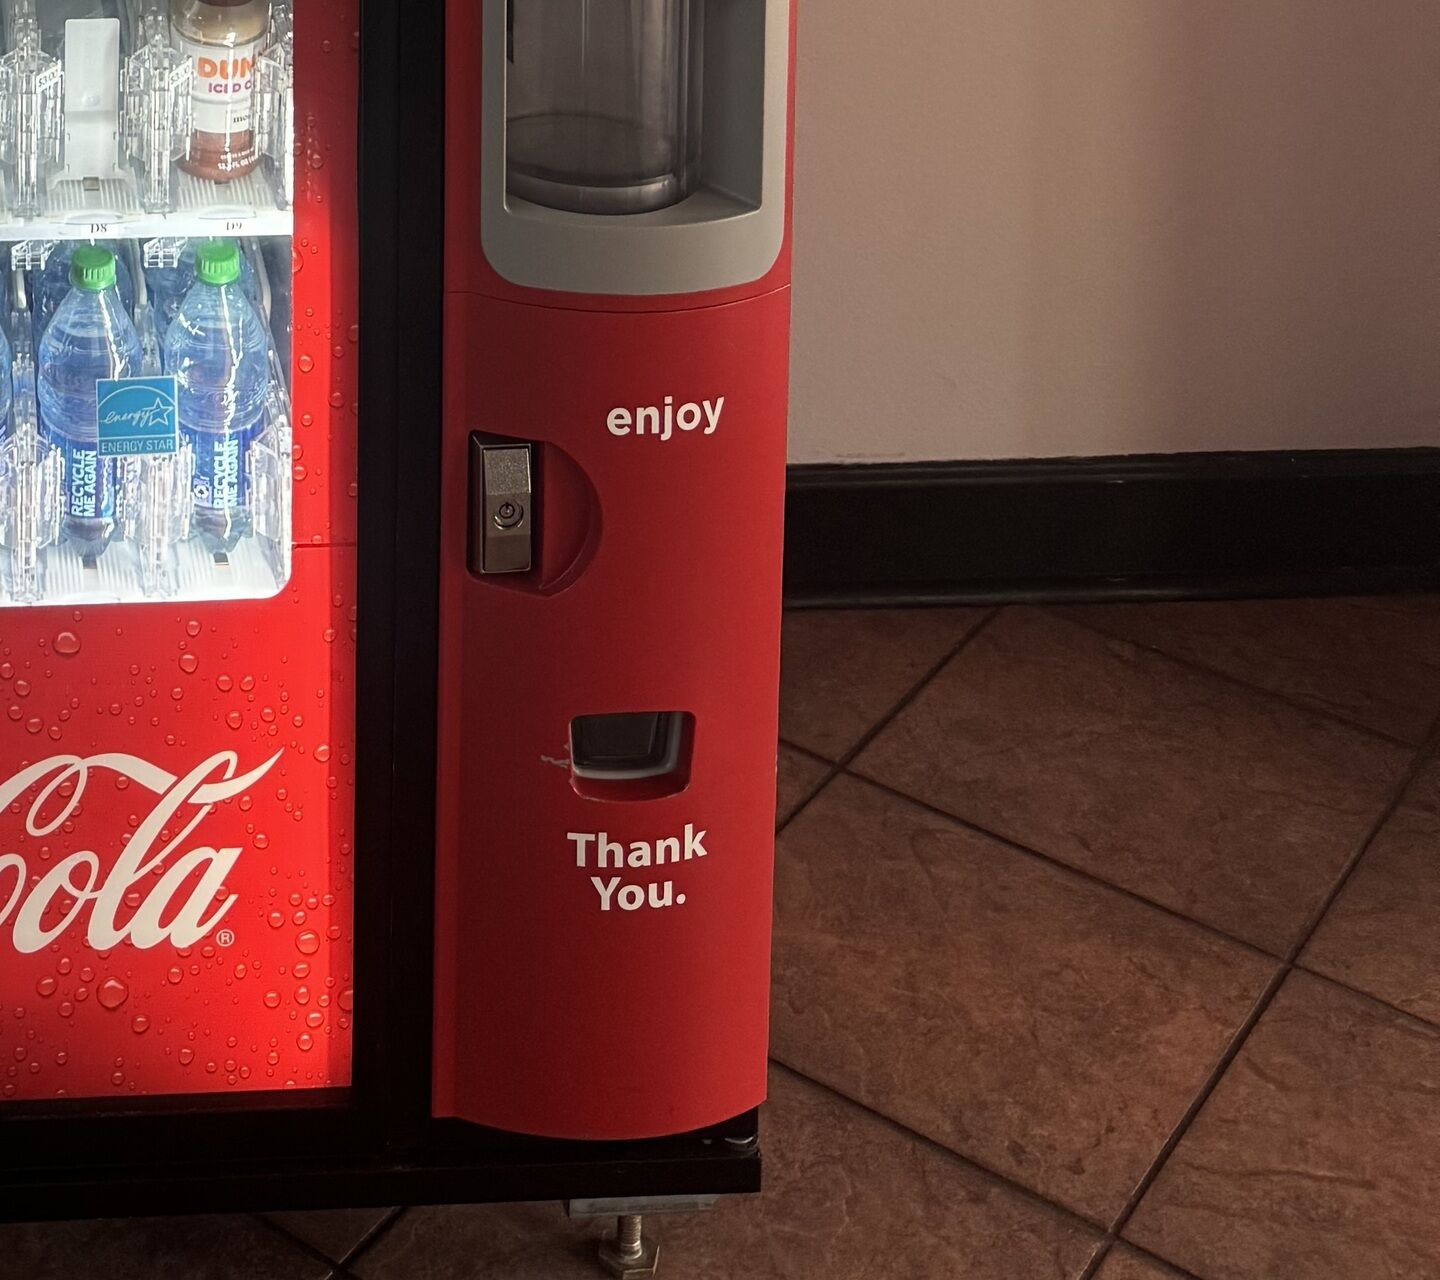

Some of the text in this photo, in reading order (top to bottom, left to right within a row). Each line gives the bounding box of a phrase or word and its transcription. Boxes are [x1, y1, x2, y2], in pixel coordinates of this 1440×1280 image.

[38, 69, 60, 88] $3.00
[197, 57, 255, 80] DUN
[90, 222, 107, 233] D8
[225, 221, 242, 231] D9
[105, 405, 151, 426] energy
[605, 395, 725, 440] enjoy
[101, 439, 173, 453] ENERGY STAR
[71, 448, 86, 517] RECYCLE
[84, 450, 97, 517] ME AGAIN
[213, 441, 227, 509] RECYCLE
[567, 823, 708, 869] Thank
[590, 874, 686, 911] You.
